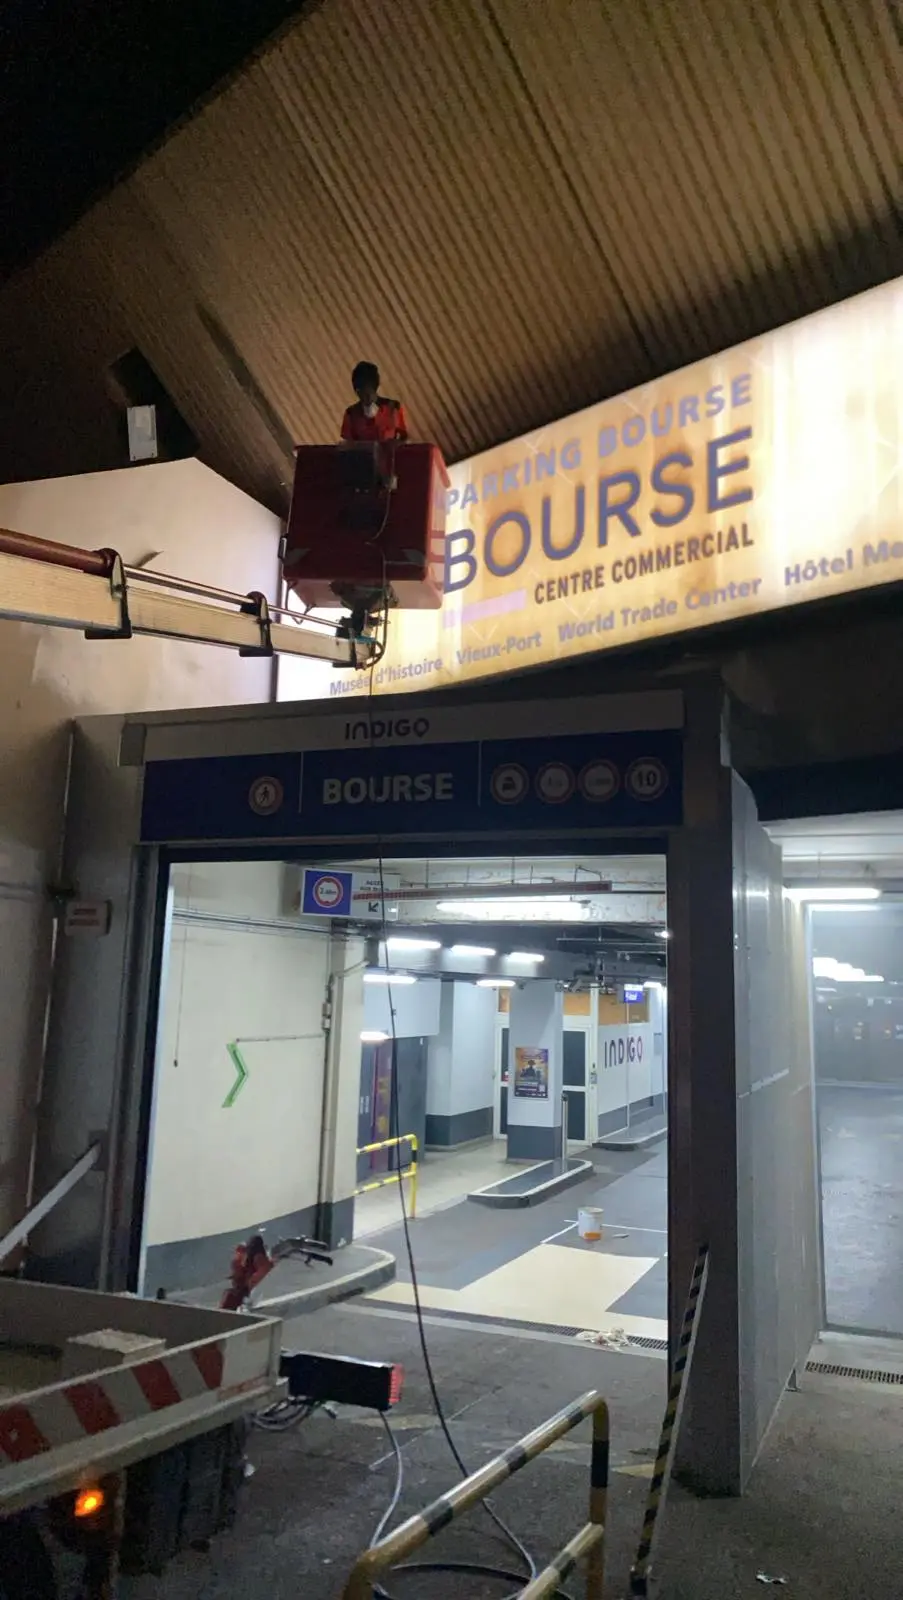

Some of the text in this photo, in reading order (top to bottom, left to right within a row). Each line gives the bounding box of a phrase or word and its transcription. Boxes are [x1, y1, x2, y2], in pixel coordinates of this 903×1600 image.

[446, 373, 753, 515] PARKING BOURSE
[443, 426, 754, 594] BOURSE
[534, 522, 755, 605] CENTRE COMMERCIAL
[330, 671, 370, 696] Musée
[375, 657, 444, 685] d'histoire
[456, 631, 542, 665] Vieux-Port
[558, 614, 615, 642] World
[620, 597, 678, 626] Trade
[684, 576, 763, 611] Center
[784, 547, 854, 587] Hôtel
[344, 717, 430, 740] INDIGO
[322, 772, 454, 805] BOURSE
[635, 769, 657, 789] 10
[604, 1035, 643, 1069] INDIGO
